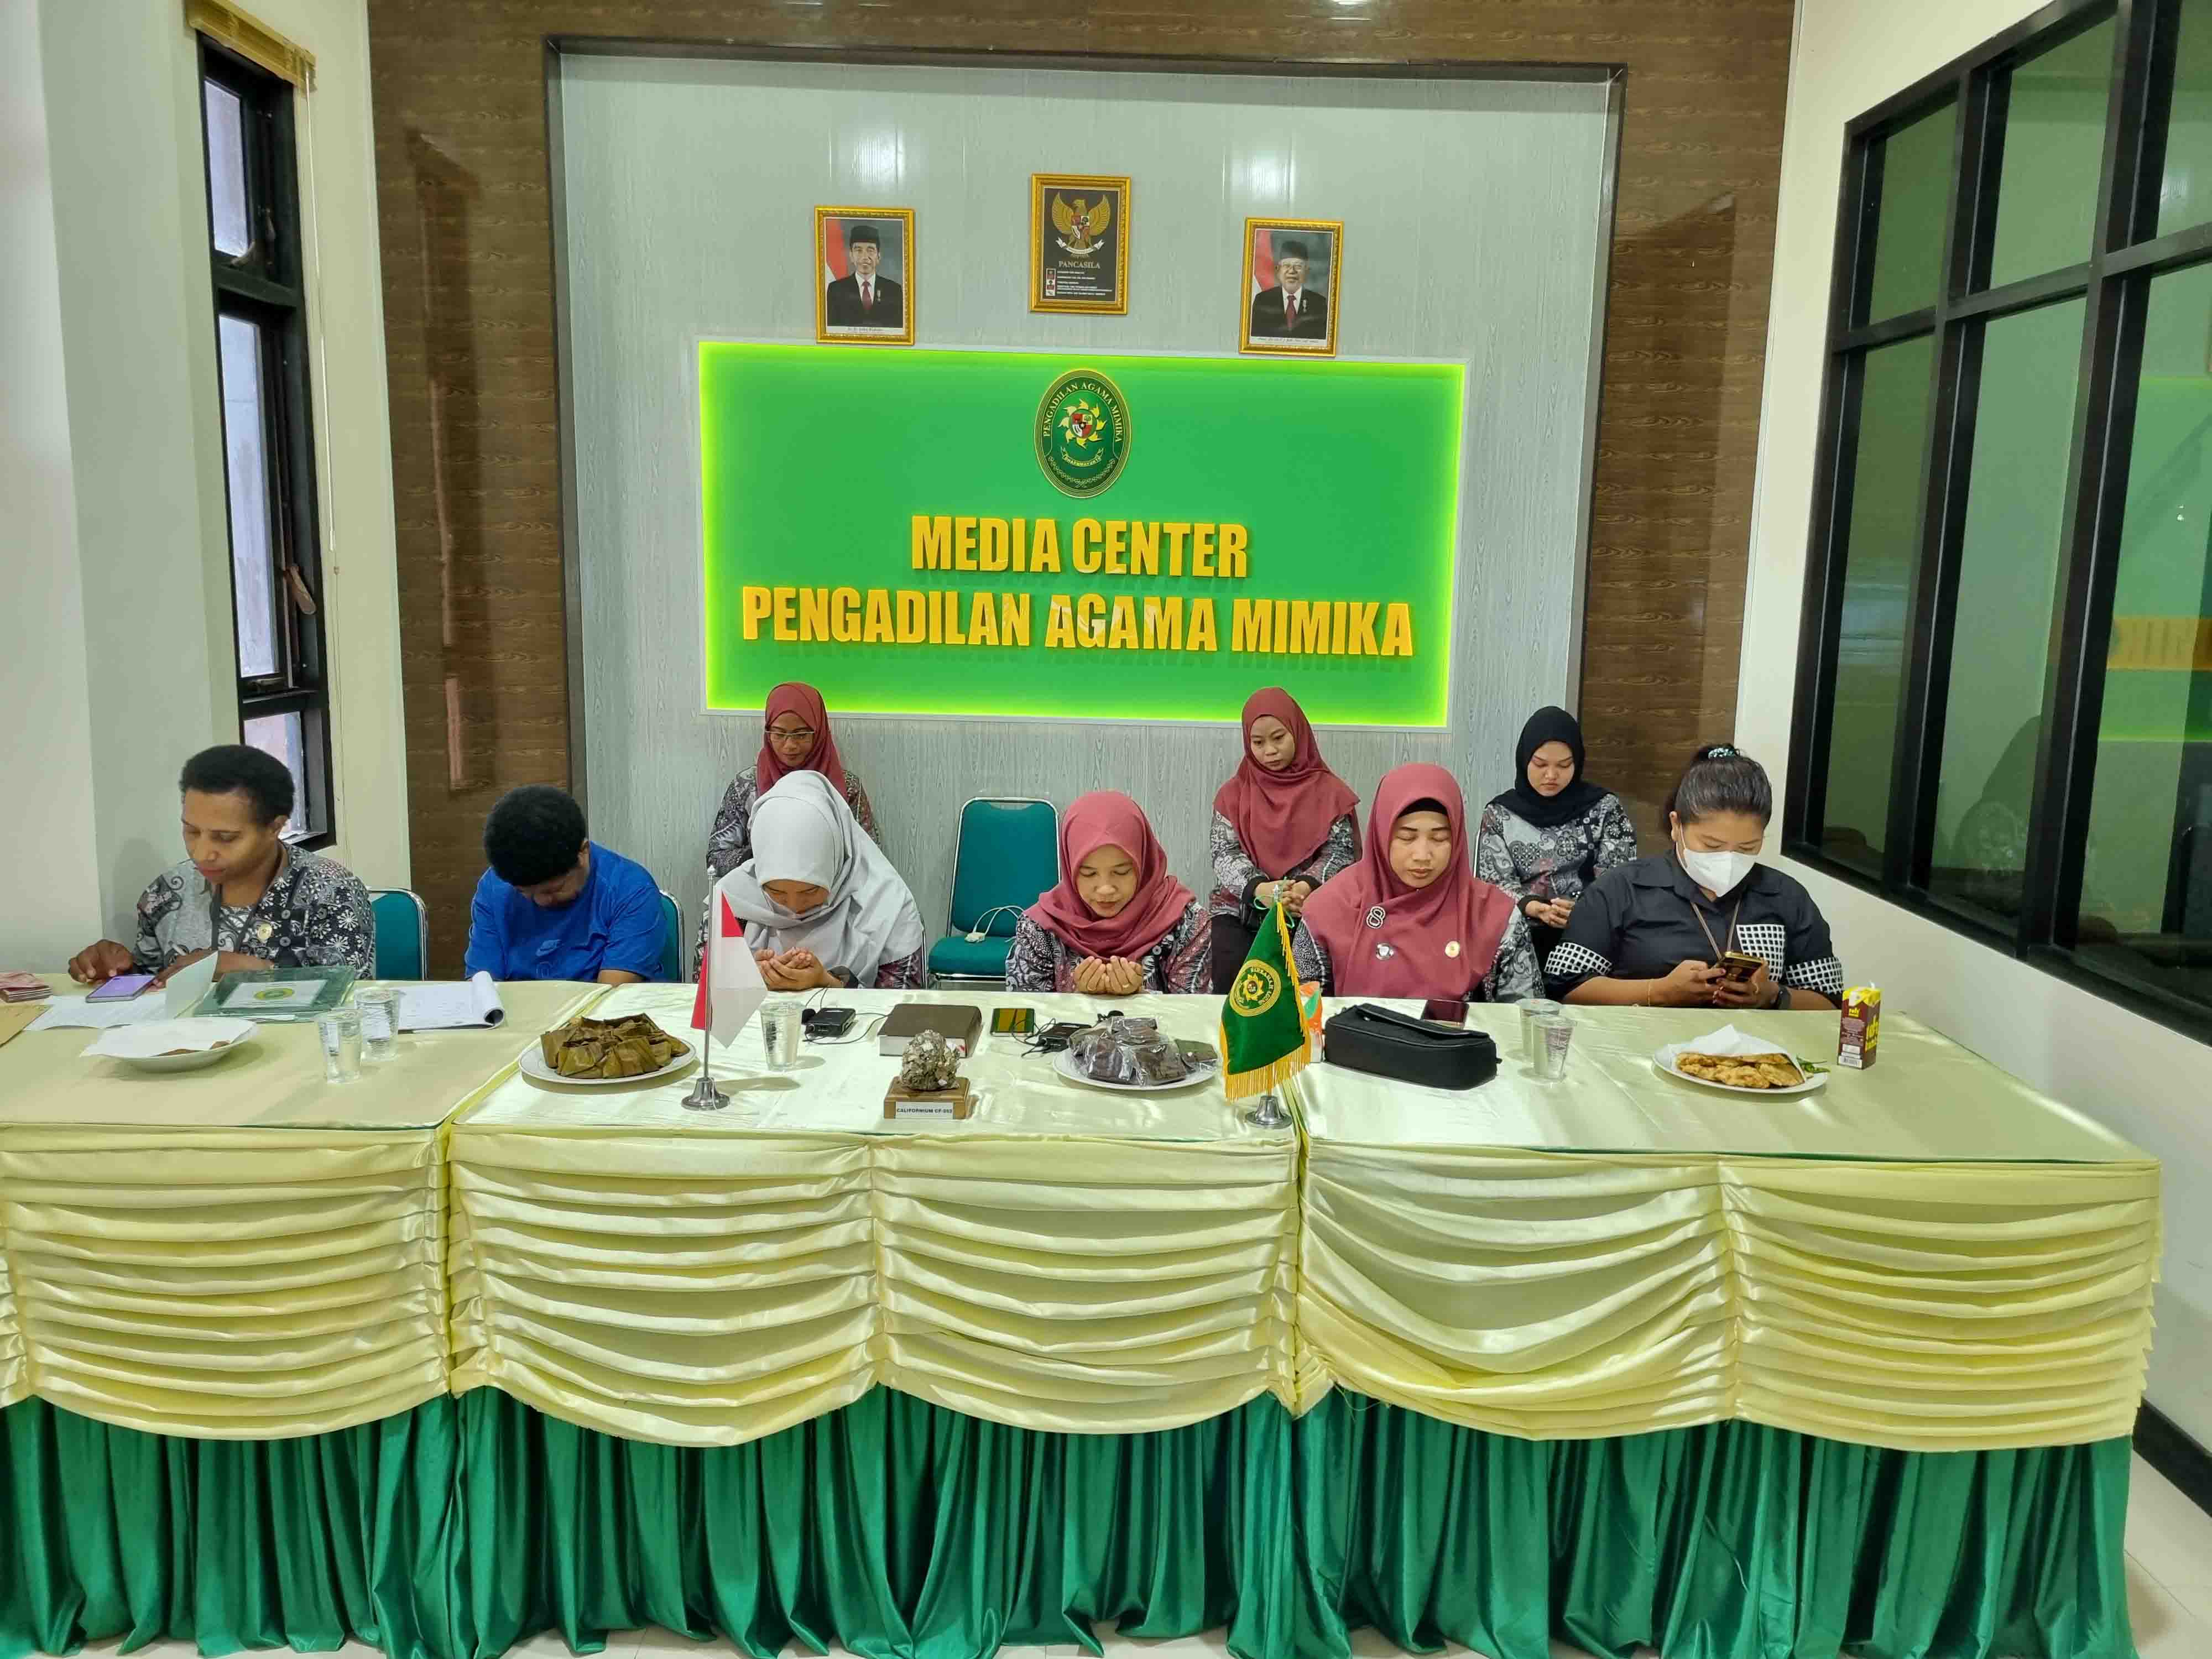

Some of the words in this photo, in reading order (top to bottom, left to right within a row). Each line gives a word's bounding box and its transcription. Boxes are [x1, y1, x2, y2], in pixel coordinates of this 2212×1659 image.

[1058, 260, 1100, 269] PANCASILA
[1043, 382, 1078, 437] PENGADILAN
[1081, 381, 1113, 405] AGAMA
[1110, 404, 1124, 442] MIMIKA
[912, 515, 1061, 573] MEDIA
[1072, 518, 1249, 578] CENTER
[742, 586, 1031, 647] PENGADILAN
[1044, 593, 1218, 652] AGAMA
[1230, 598, 1414, 656] MIMIKA
